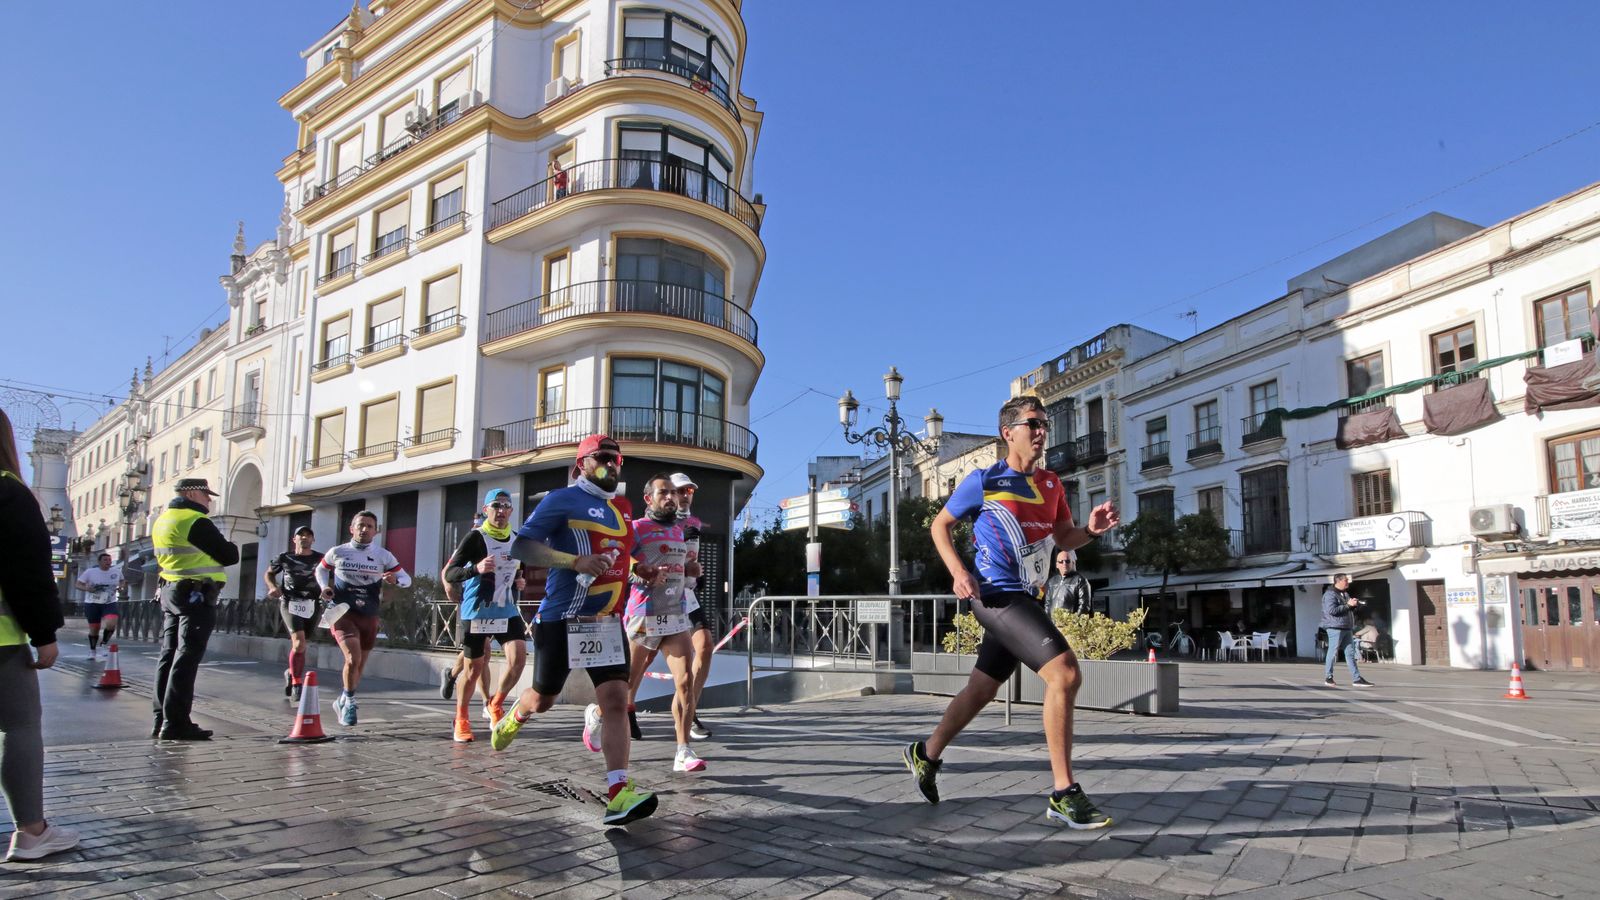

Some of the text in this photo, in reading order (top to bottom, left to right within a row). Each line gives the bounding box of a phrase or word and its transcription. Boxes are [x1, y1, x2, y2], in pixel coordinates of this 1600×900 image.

[338, 561, 378, 571] Movijerez
[1530, 560, 1549, 569] LA
[579, 640, 603, 655] 220
